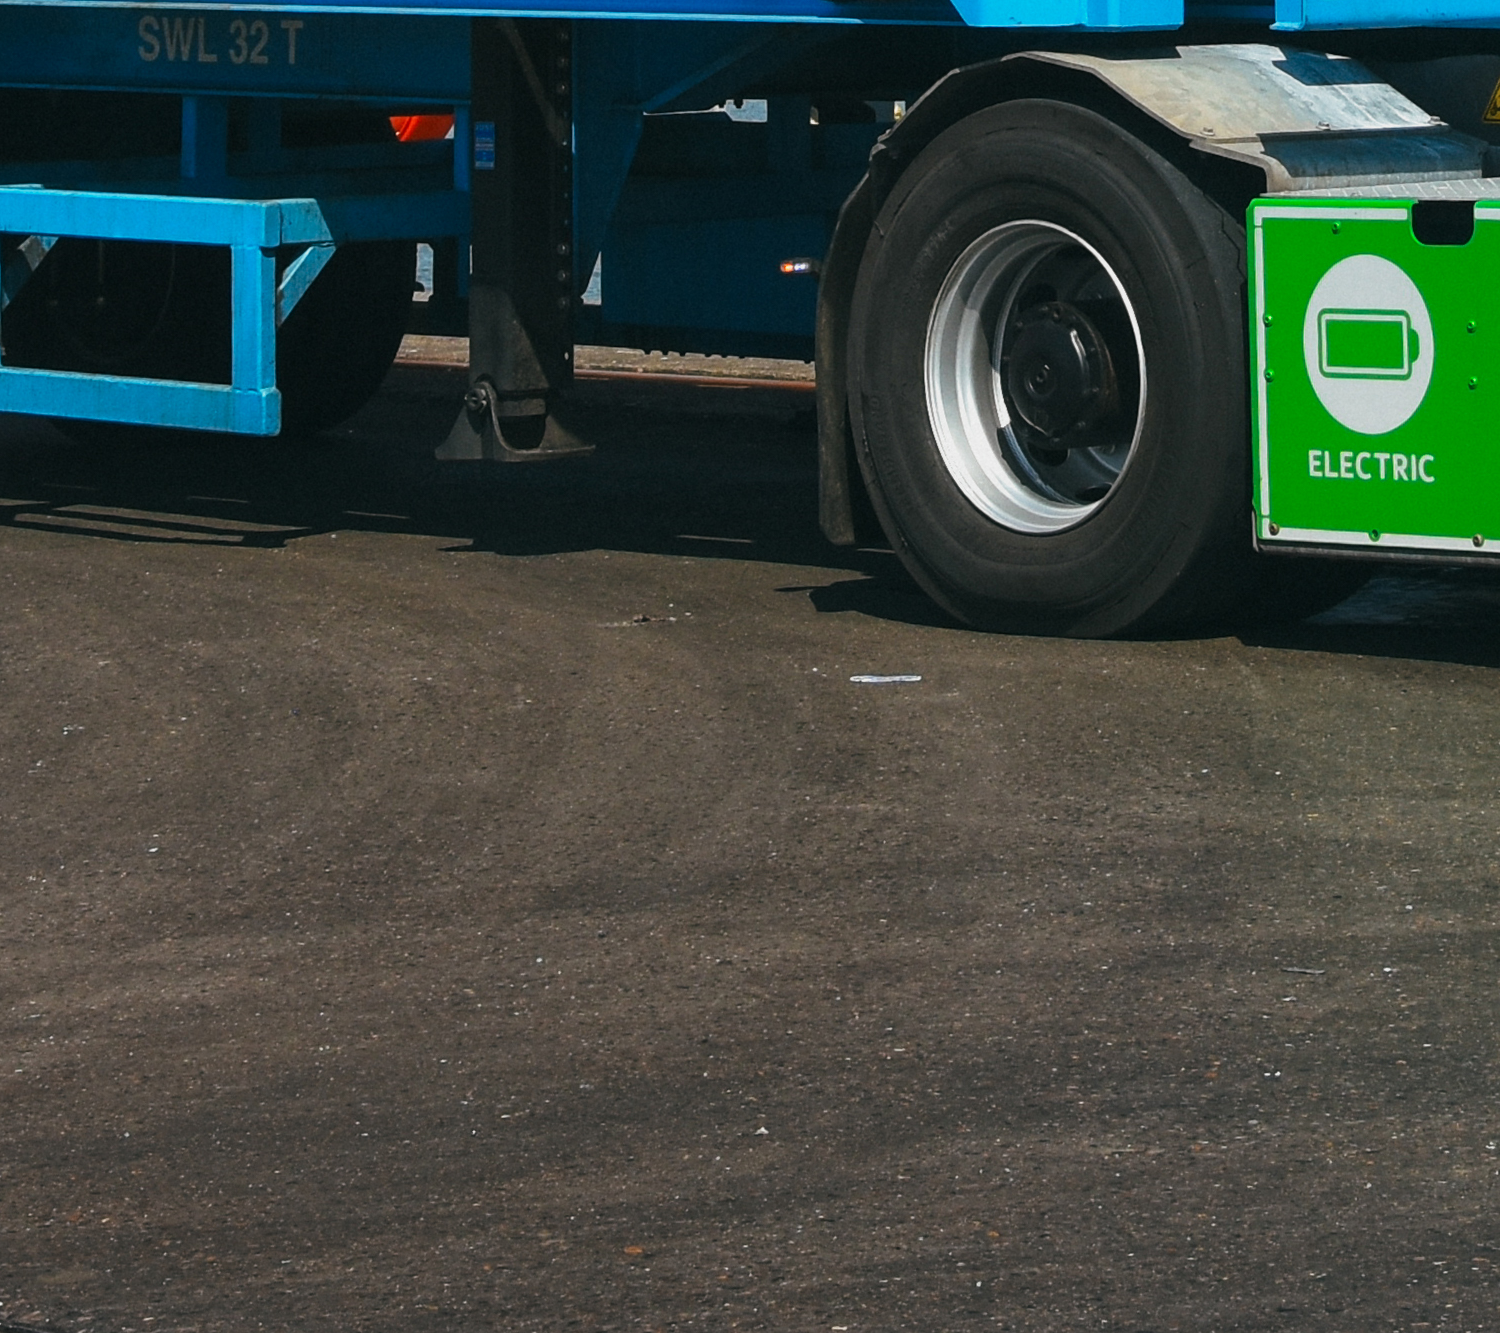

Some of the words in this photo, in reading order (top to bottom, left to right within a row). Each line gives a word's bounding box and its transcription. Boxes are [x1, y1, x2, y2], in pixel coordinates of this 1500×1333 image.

[138, 15, 218, 62] SWL
[229, 19, 269, 65] 32
[280, 20, 304, 65] T
[1307, 449, 1436, 484] ELECTRIC
